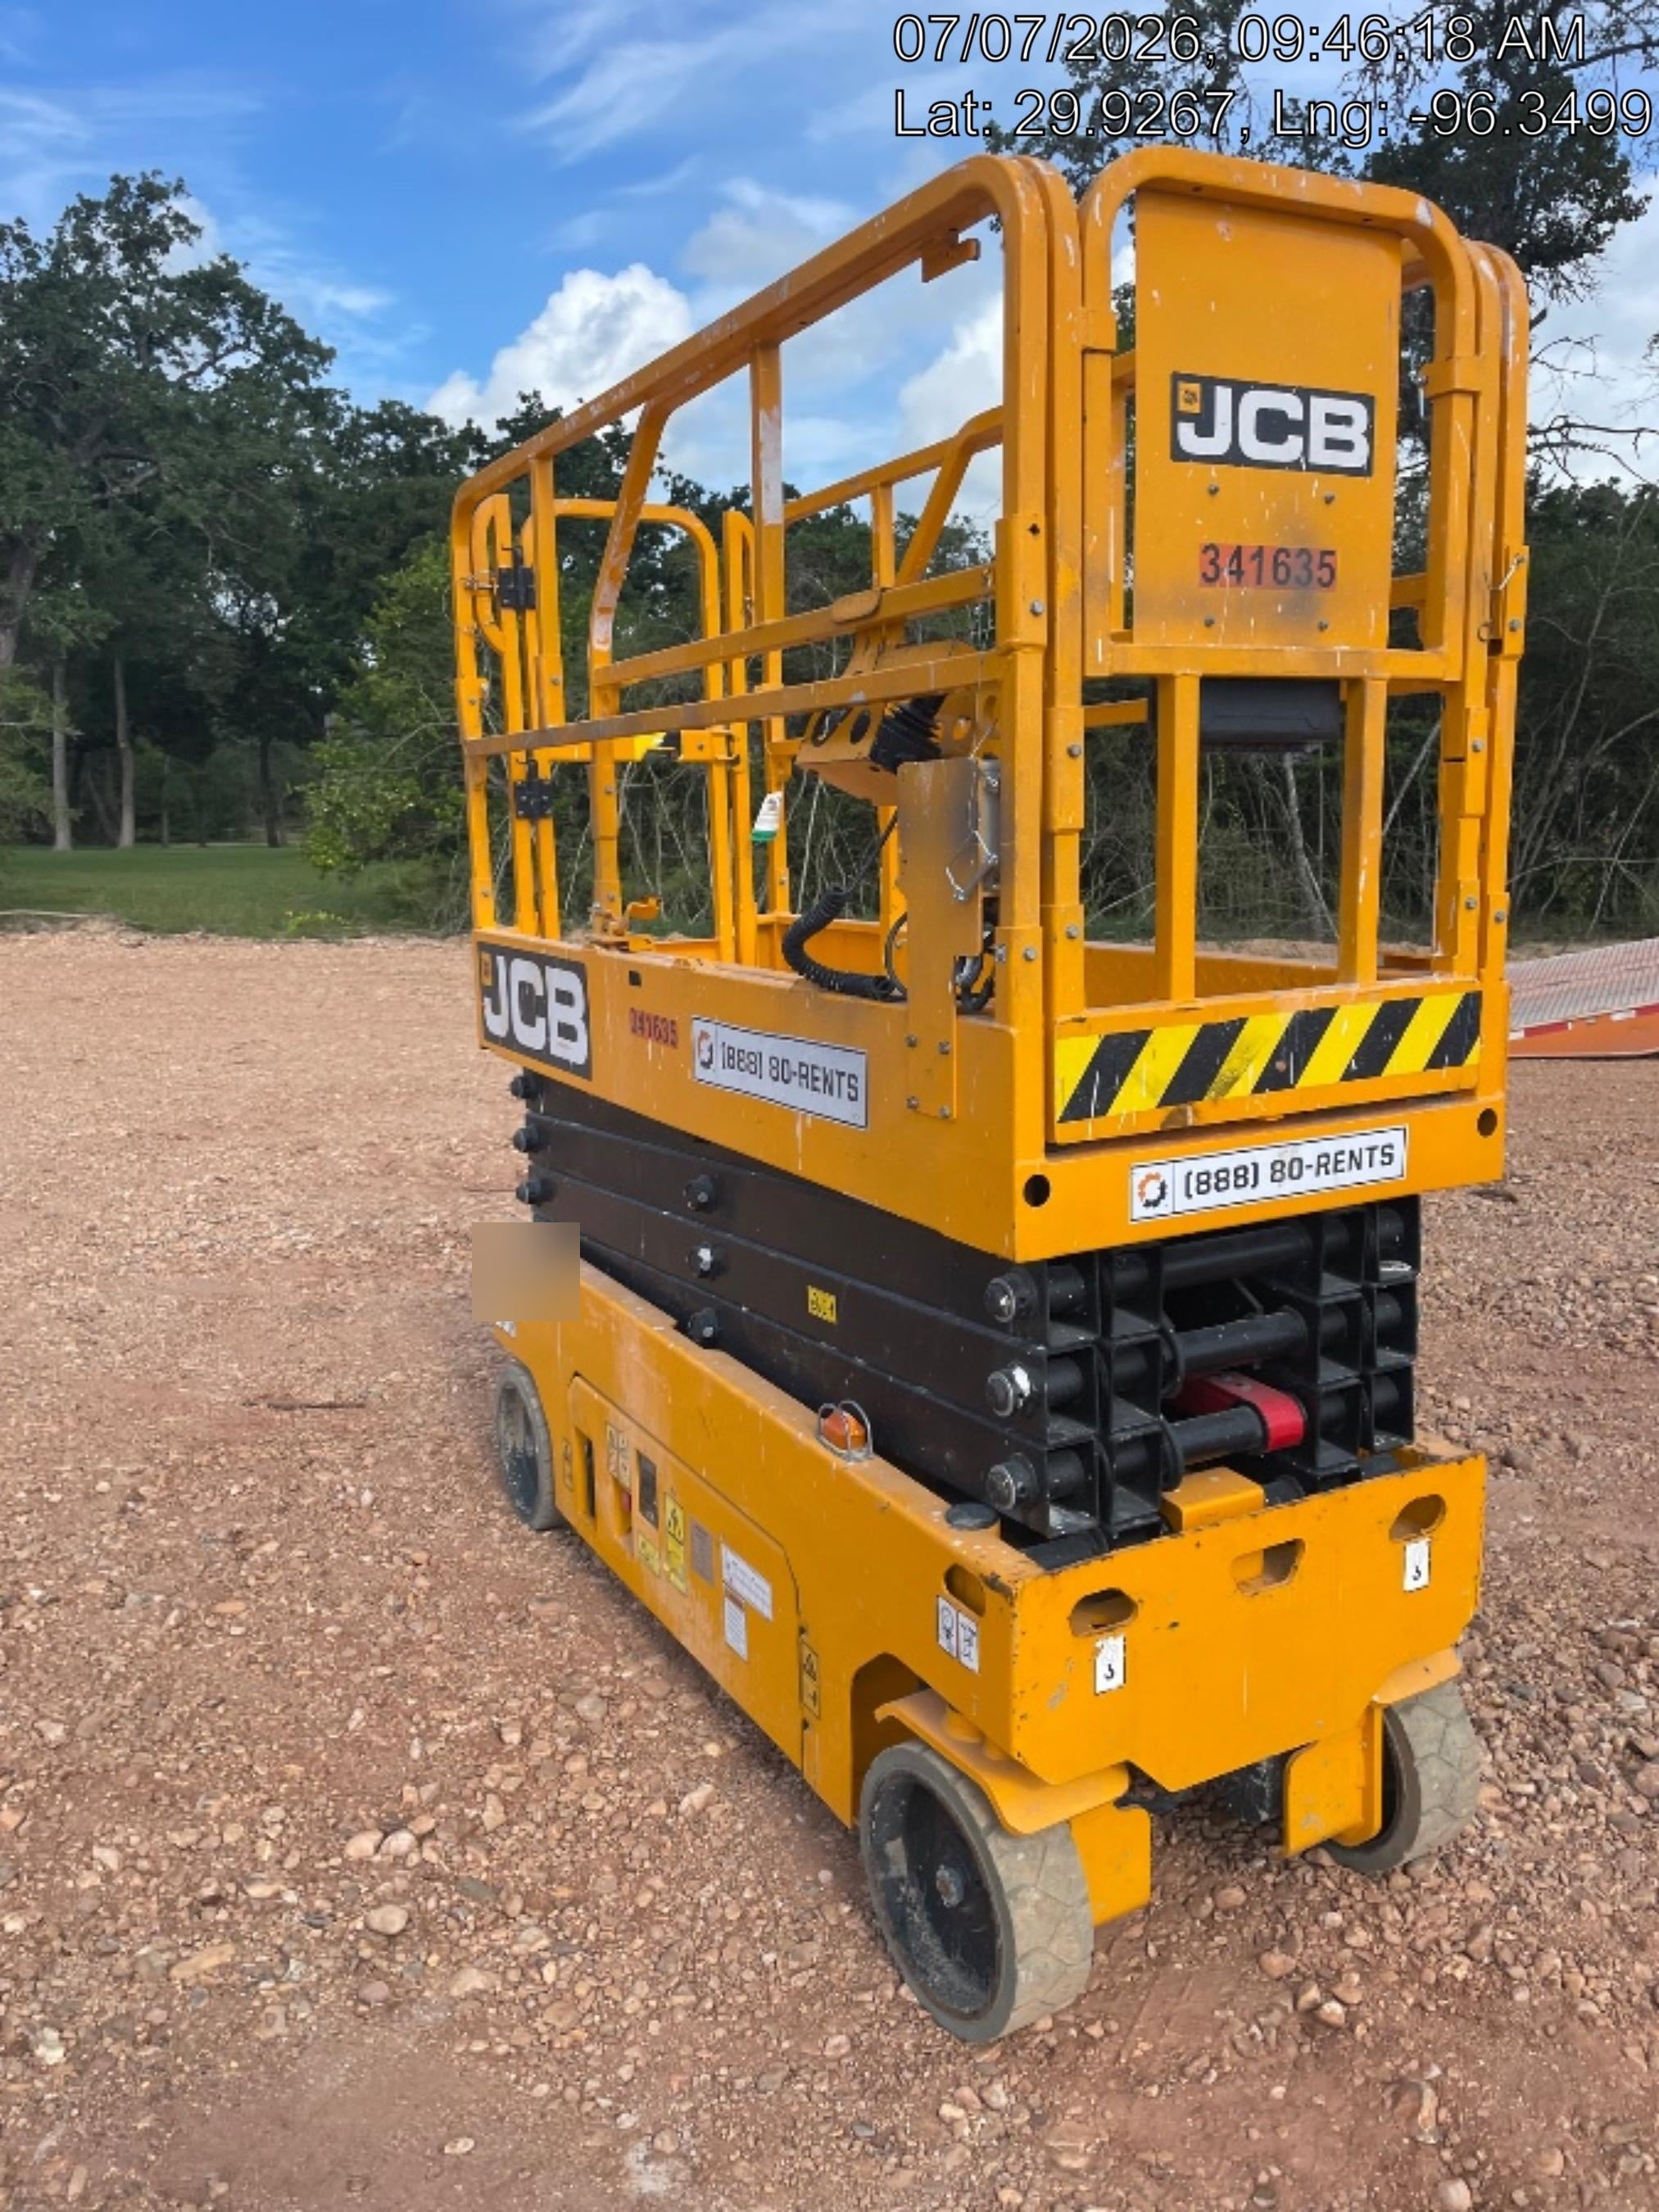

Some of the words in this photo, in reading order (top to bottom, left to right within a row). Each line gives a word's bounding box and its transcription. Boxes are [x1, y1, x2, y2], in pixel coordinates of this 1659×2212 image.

[1176, 384, 1371, 469] JCB
[1200, 542, 1337, 588] 341635
[483, 954, 588, 1065] JCB
[768, 1055, 859, 1102] 80-RENTS
[1184, 1162, 1260, 1199] (888)
[1269, 1142, 1395, 1184] 80-RENTS
